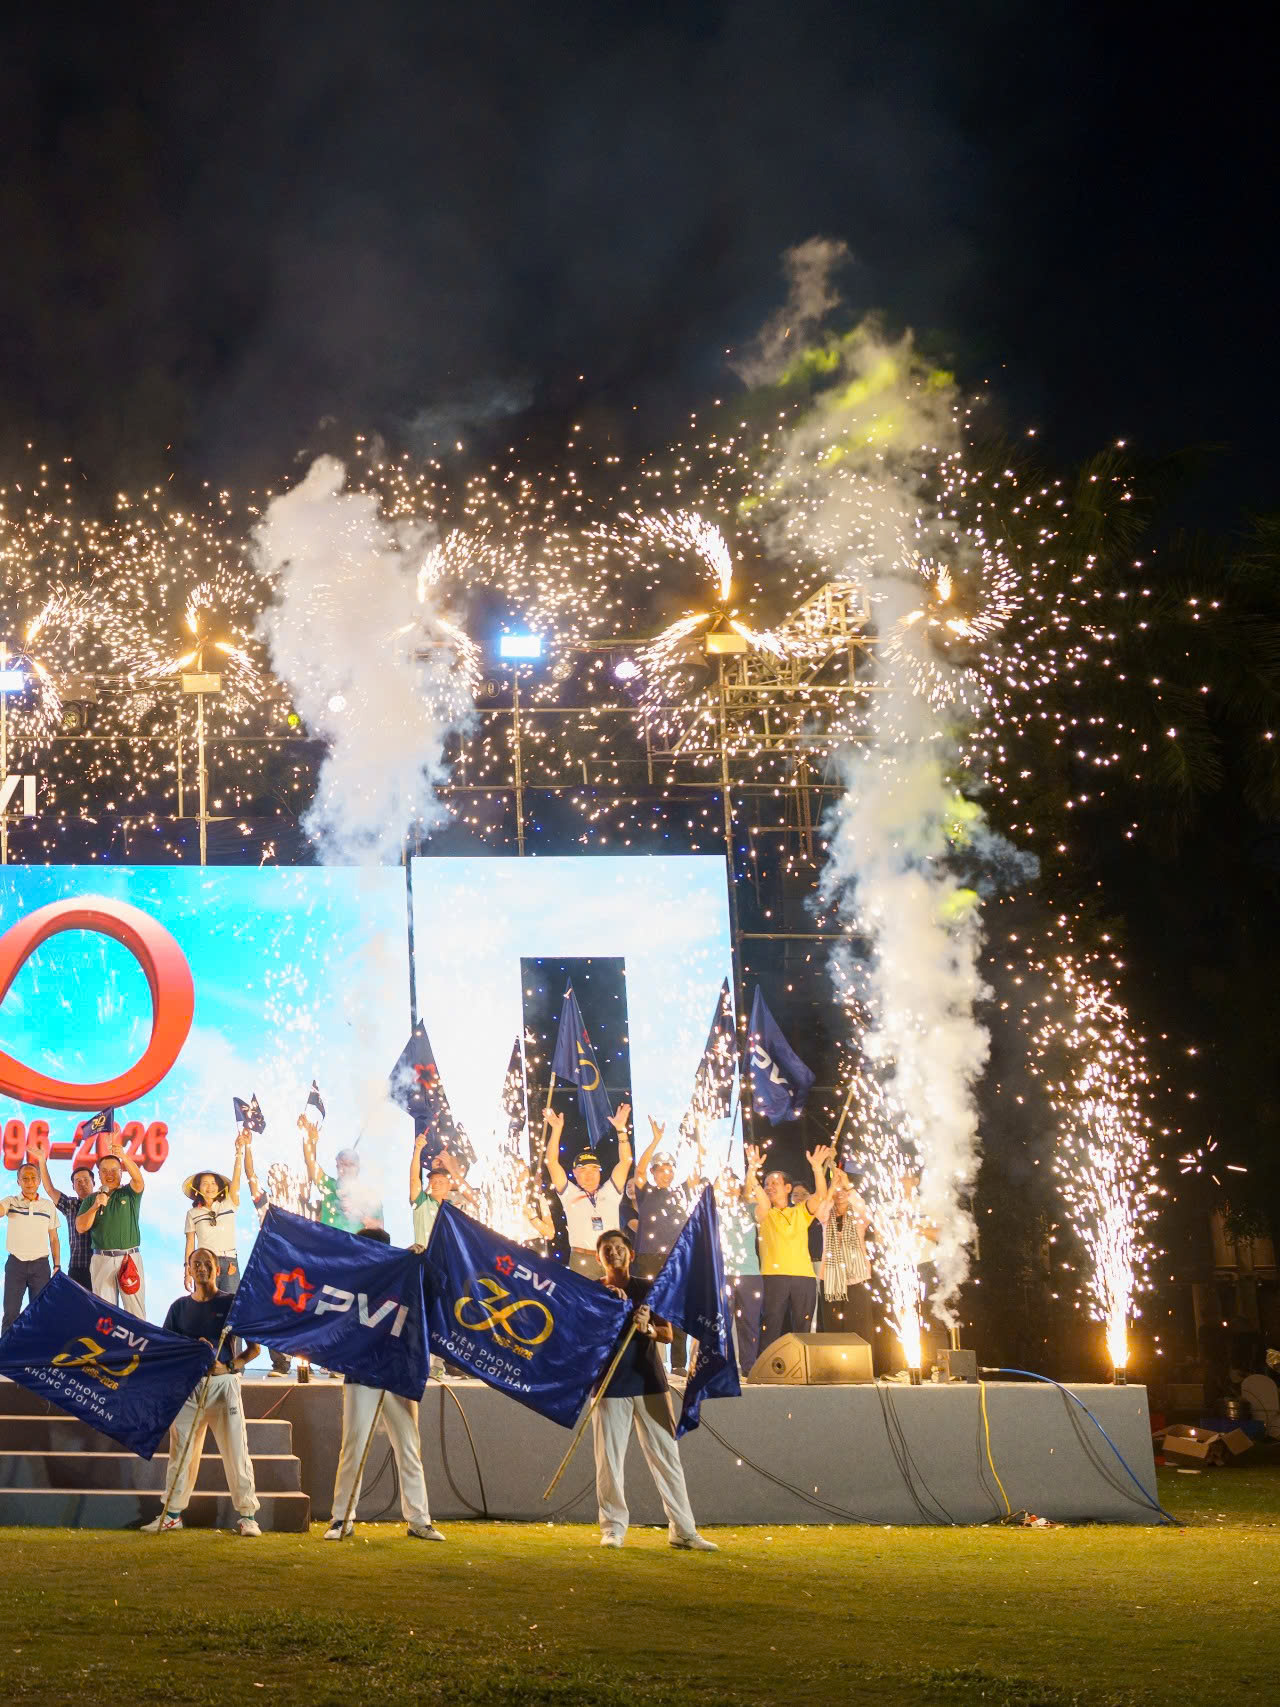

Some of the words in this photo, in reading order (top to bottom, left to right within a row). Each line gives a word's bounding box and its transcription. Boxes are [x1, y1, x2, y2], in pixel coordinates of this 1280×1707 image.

[512, 1263, 557, 1297] PVI
[314, 1284, 409, 1338] PVI
[454, 1278, 555, 1345] 30
[696, 1314, 727, 1340] KHÔN
[111, 1324, 150, 1352] PVI
[449, 1330, 476, 1352] TIÊN
[479, 1348, 522, 1377] PHONG
[24, 1366, 62, 1389] KHÔNG
[431, 1332, 472, 1361] KHÔNG
[504, 1375, 532, 1393] HẠN
[42, 1367, 67, 1381] IÊN
[68, 1379, 107, 1406] PHONG
